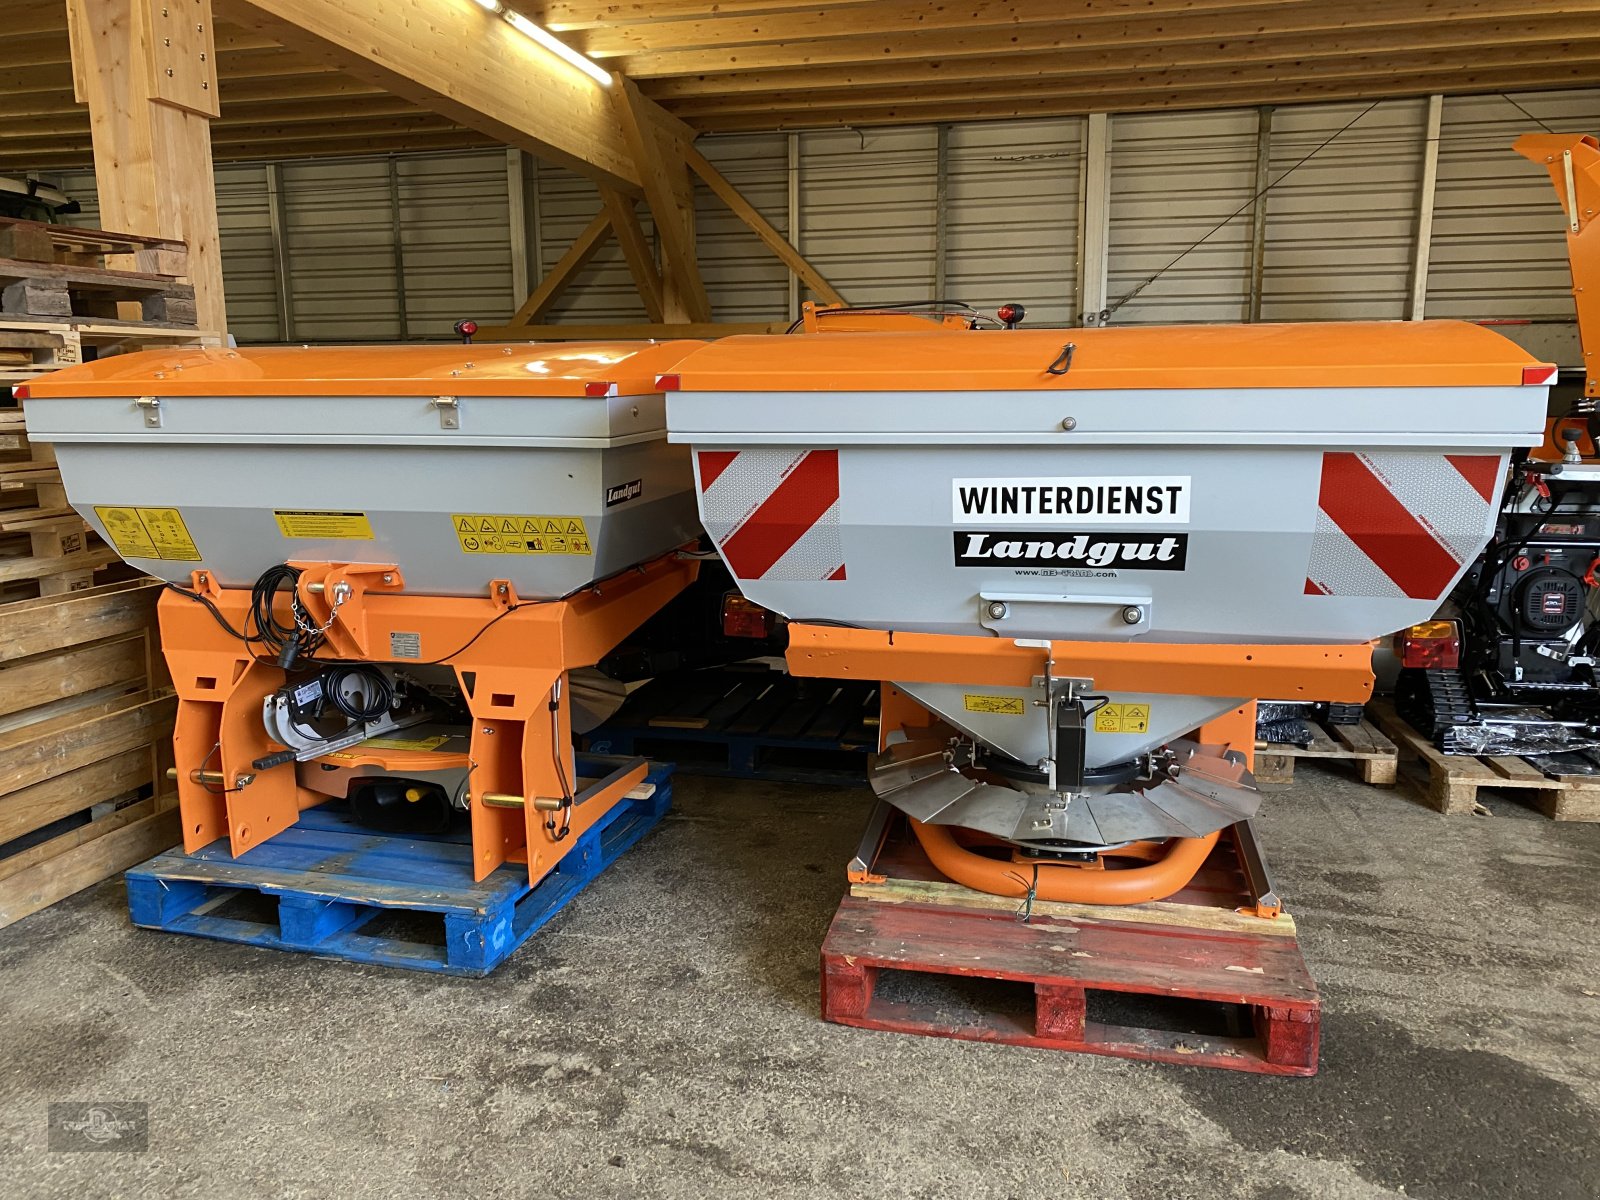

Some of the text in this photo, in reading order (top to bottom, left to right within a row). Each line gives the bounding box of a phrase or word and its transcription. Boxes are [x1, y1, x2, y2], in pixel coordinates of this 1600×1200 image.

[607, 481, 641, 503] Landgut
[959, 486, 1182, 515] WINTERDIENST
[960, 533, 1179, 567] Landgut
